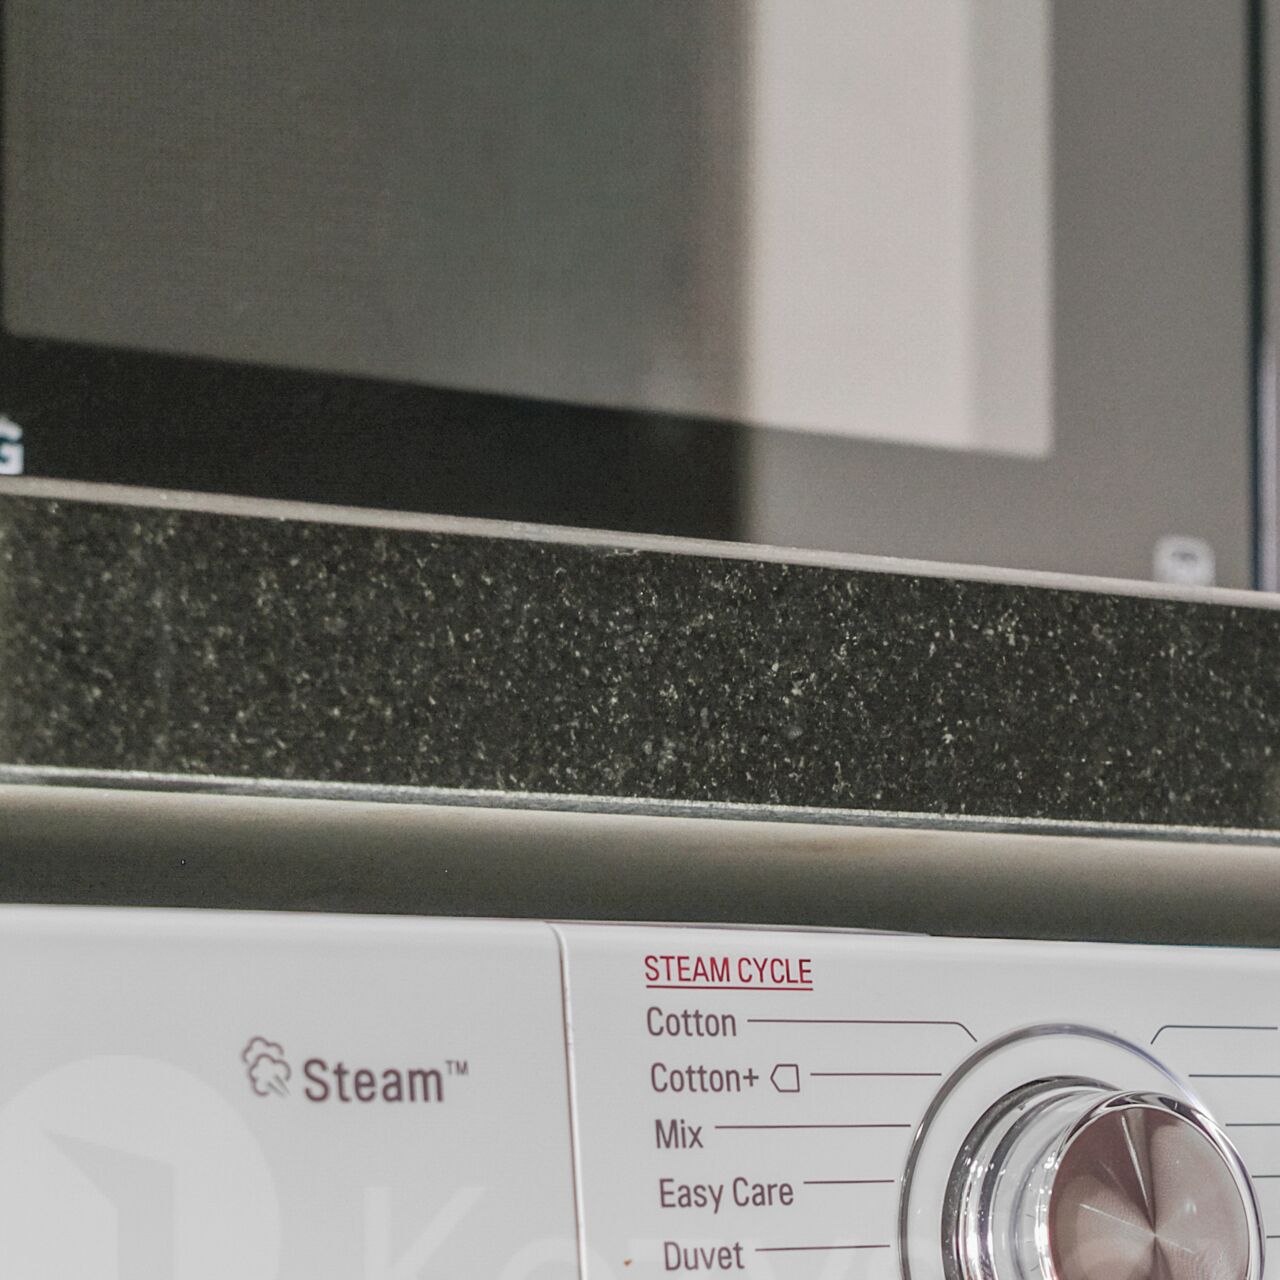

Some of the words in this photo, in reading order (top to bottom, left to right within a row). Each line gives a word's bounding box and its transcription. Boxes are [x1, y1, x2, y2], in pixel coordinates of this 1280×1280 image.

[644, 955, 730, 982] STEAM
[738, 957, 813, 984] CYCLE
[646, 1006, 737, 1037] Cotton
[650, 1063, 759, 1093] Cotton+
[654, 1119, 704, 1149] Mix
[659, 1178, 723, 1214] Easy
[732, 1177, 794, 1207] Care
[664, 1241, 745, 1271] Duvet
